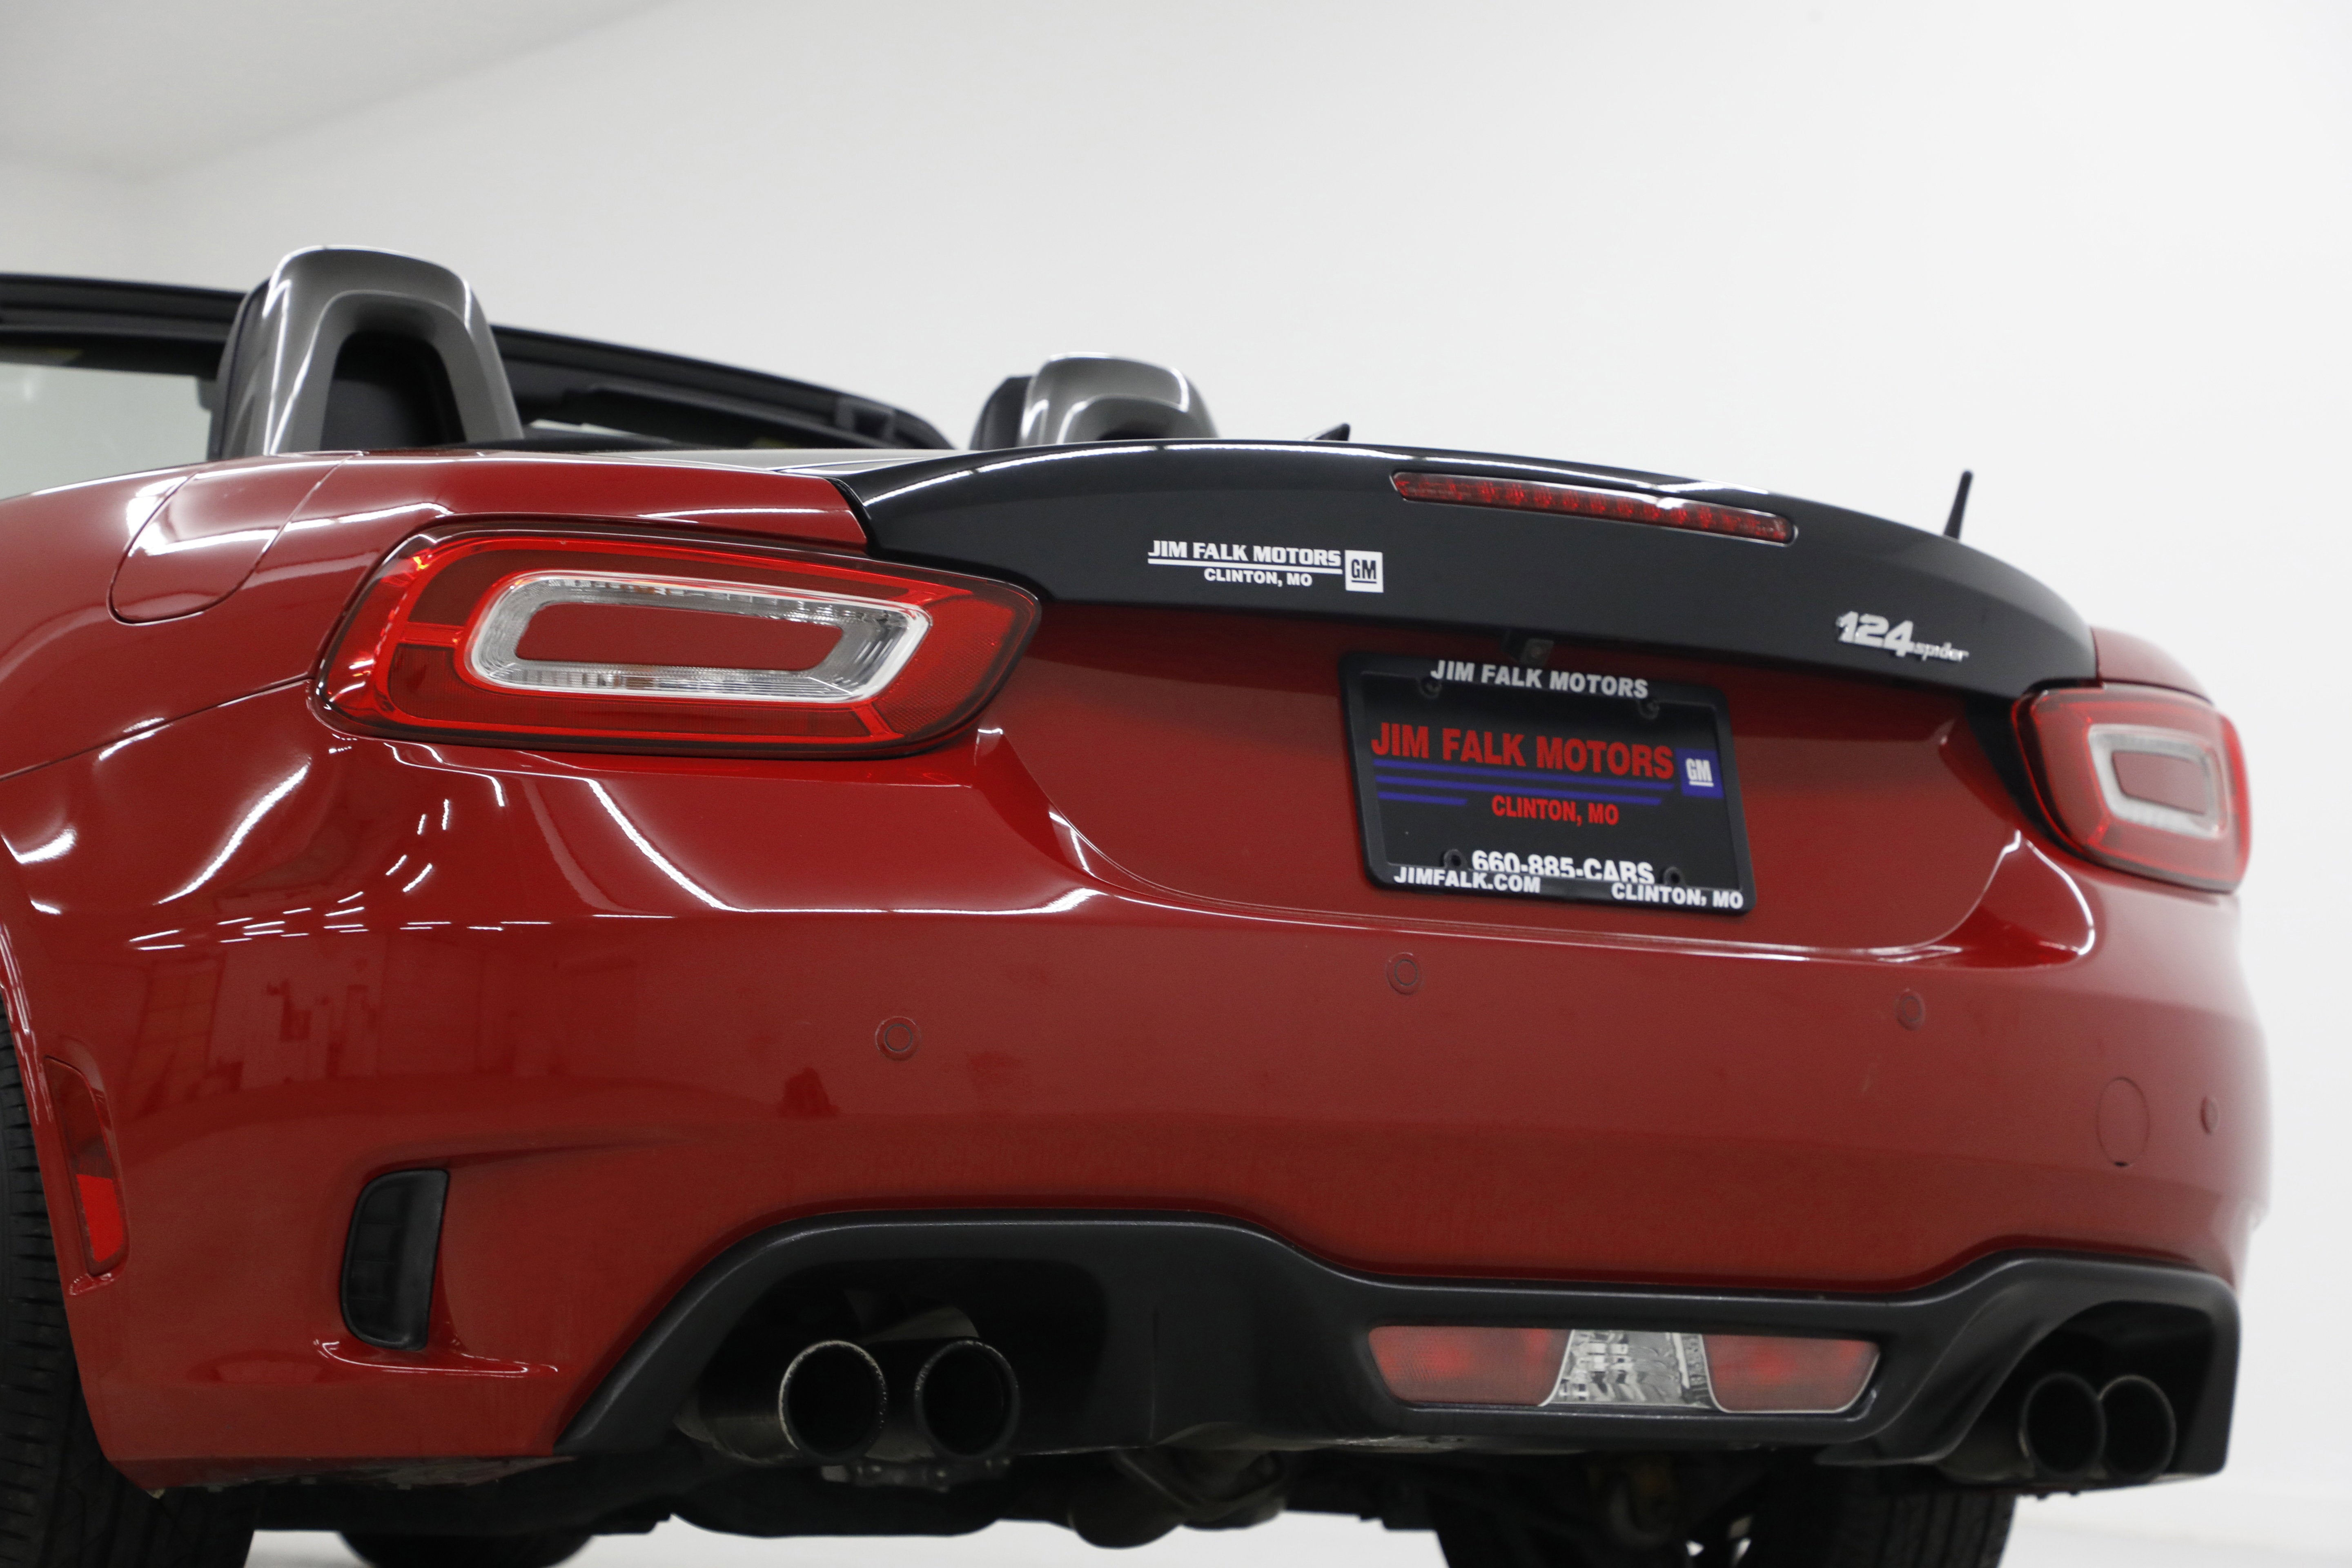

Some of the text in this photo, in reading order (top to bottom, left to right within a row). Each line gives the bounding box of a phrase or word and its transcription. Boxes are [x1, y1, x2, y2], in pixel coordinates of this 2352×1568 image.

[1148, 540, 1341, 566] JIM FALK MOTORS
[1204, 568, 1312, 587] CLINTON, MO
[1351, 559, 1376, 579] GM
[1836, 611, 1915, 657] 124
[1430, 660, 1648, 698] JIM FALK MOTORS
[1372, 722, 1674, 779] JIM FALK MOTORS
[1686, 758, 1713, 783] GM
[1492, 795, 1619, 826] CLINTON, MO
[1393, 866, 1541, 893] JIMFALK.COM
[1472, 850, 1655, 885] 660-885-CARS
[1611, 882, 1744, 909] CLINTON, MO
